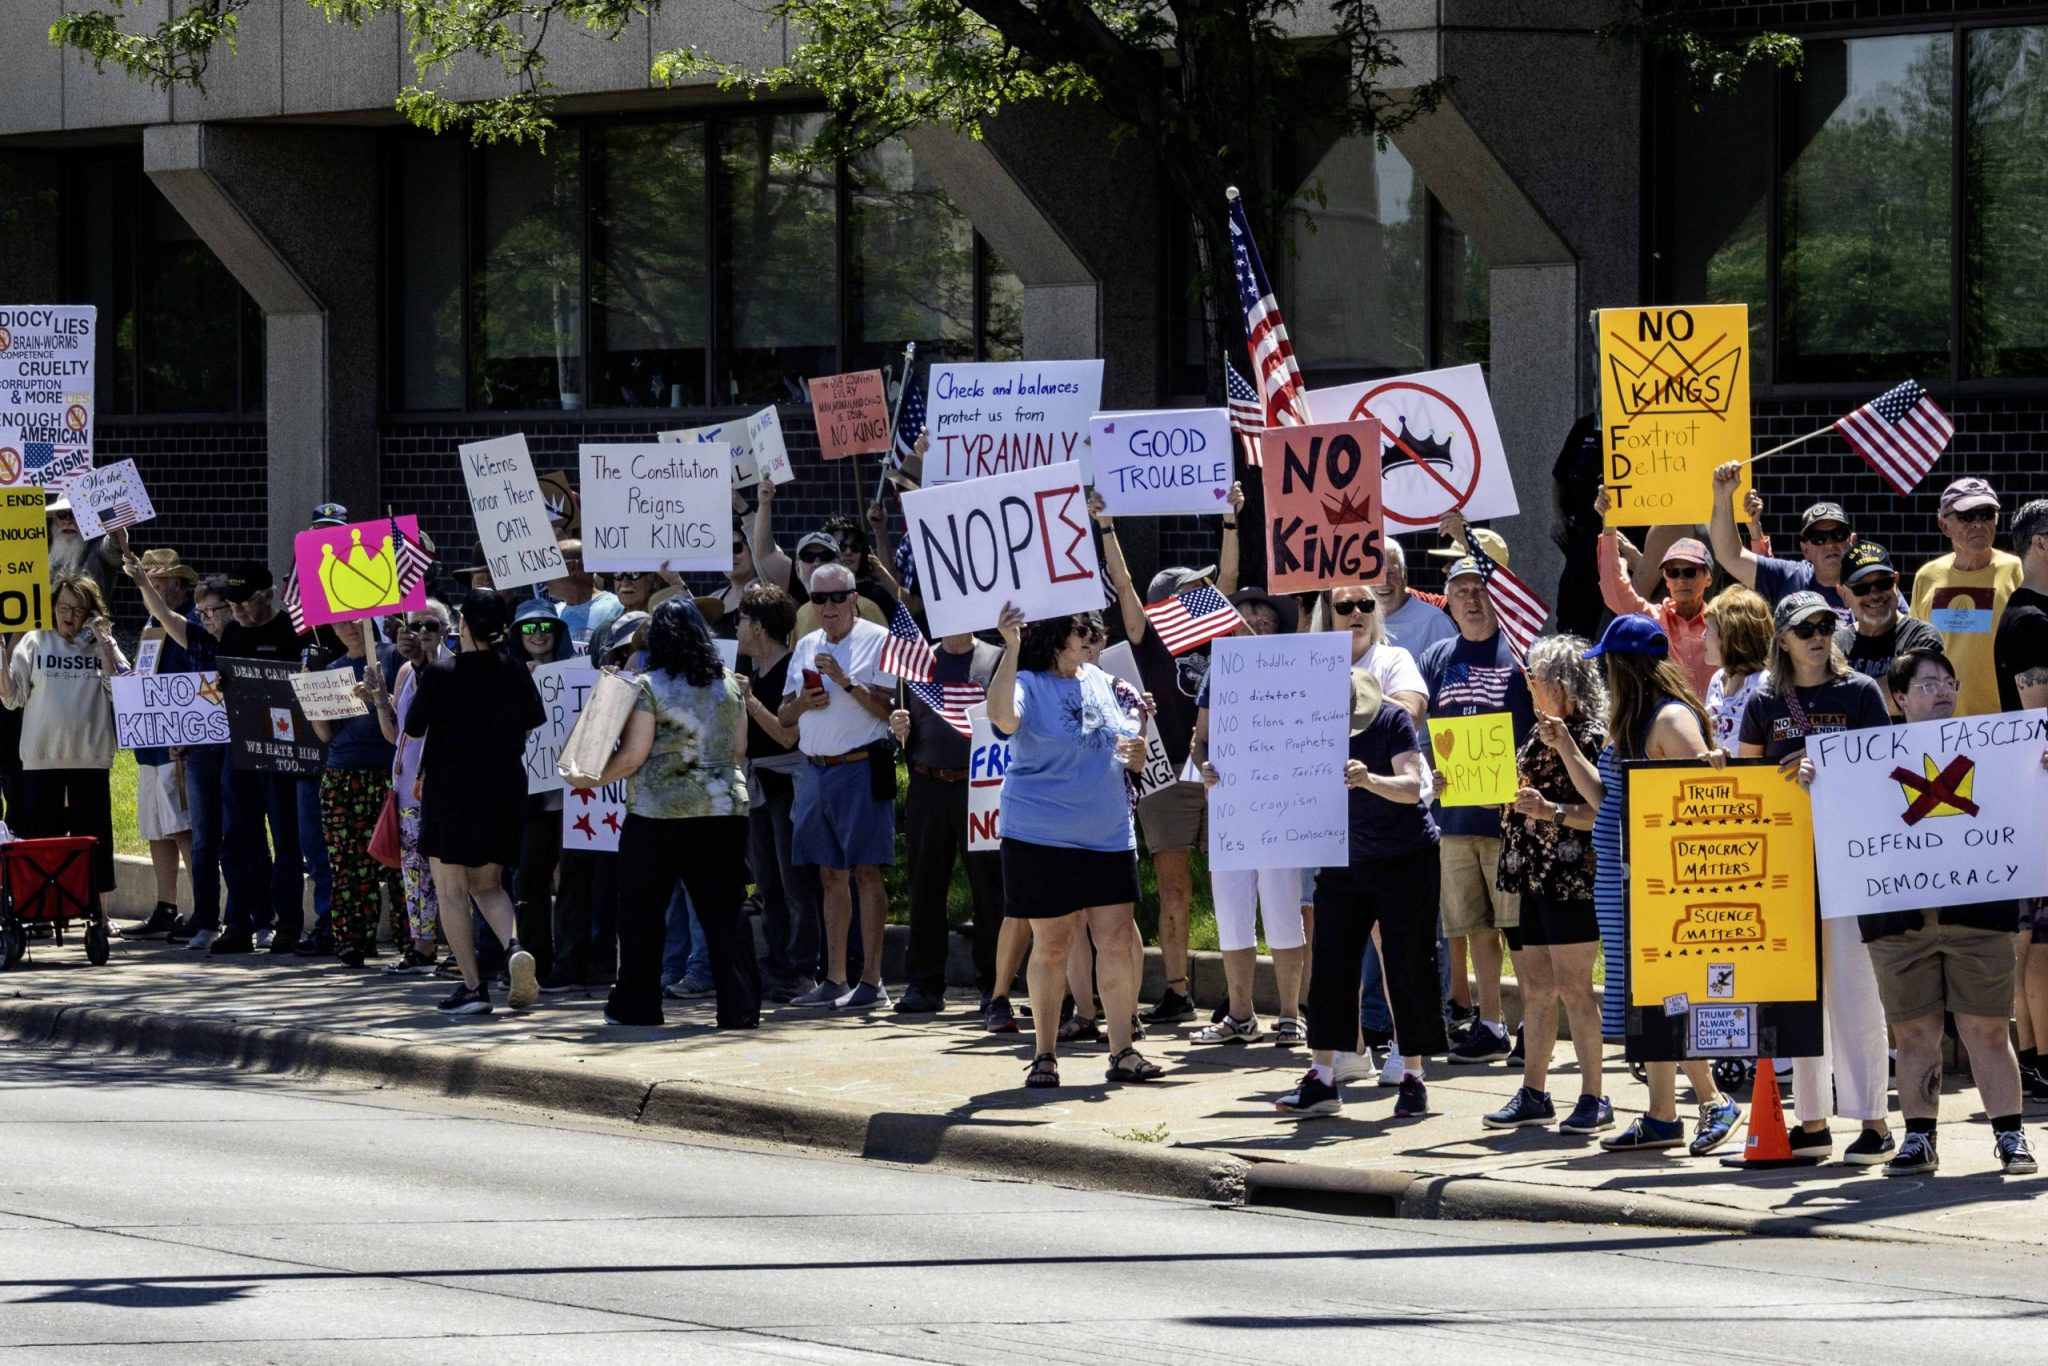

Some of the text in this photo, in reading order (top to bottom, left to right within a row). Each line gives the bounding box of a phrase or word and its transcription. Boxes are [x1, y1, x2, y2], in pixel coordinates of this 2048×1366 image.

[54, 318, 89, 335] LIES
[1639, 310, 1694, 342] NO
[13, 335, 78, 350] BRAIN-WORMS
[19, 360, 89, 376] CRUELTY
[0, 380, 62, 390] ORRUPTION
[833, 386, 857, 399] EVERY
[936, 372, 1080, 400] Checks and balances
[1632, 375, 1720, 407] KINGS
[11, 390, 90, 404] & MORE LIES
[0, 412, 62, 427] NOUGH
[938, 406, 1045, 433] protect us from
[20, 427, 88, 444] AMERICAN
[831, 418, 887, 446] NO KING!
[1129, 428, 1206, 458] GOOD
[1610, 419, 1700, 450] Foxtrot
[937, 431, 1078, 476] TYRANNY
[1282, 434, 1361, 494] NO
[1611, 449, 1686, 479] Delta
[30, 450, 85, 487] FASCISM
[470, 453, 517, 478] Veterns
[590, 455, 621, 480] The
[631, 455, 719, 479] Constitution
[1108, 462, 1227, 492] TROUBLE
[81, 469, 122, 490] We the
[7, 494, 43, 507] ENDS
[90, 485, 128, 507] People
[470, 480, 535, 512] honor their
[628, 487, 685, 520] Reigns
[1608, 485, 1673, 508] Taco
[0, 527, 46, 541] NOUGH
[497, 517, 531, 543] OATH
[594, 523, 716, 550] NOT KINGS
[919, 484, 1094, 602] NOPE
[1861, 544, 1882, 554] NAVY
[7, 561, 34, 575] SAY
[489, 546, 562, 579] NOT KINGS
[37, 655, 41, 669] I
[232, 665, 262, 679] DEAR
[1221, 650, 1345, 675] NO toddler Kings
[142, 675, 195, 708] NO
[312, 676, 331, 689] mad
[1218, 689, 1306, 706] NO dictators
[1218, 716, 1238, 734] NO
[1252, 714, 1284, 728] Felons
[1311, 710, 1350, 722] President
[1463, 706, 1476, 715] USA
[1774, 714, 1846, 730] NO RTREAT
[118, 711, 230, 747] KINGS
[1775, 731, 1786, 740] NO
[246, 740, 320, 761] WE HATE HIM
[1217, 743, 1236, 759] NO
[1285, 731, 1334, 753] Prophets
[1819, 730, 1909, 767] FUCK
[1217, 763, 1332, 788] NO Taco Tariffs
[1445, 763, 1501, 796] ARMY
[1687, 785, 1729, 800] TRUTH
[1217, 804, 1235, 819] NO
[1683, 803, 1755, 817] MATTERS
[1218, 832, 1244, 852] Yes
[1286, 829, 1345, 844] Democracy
[1678, 841, 1759, 860] DEMOCRACY
[1848, 826, 2014, 858] DEFEND OUR
[1684, 862, 1750, 882] MATTERS
[1867, 864, 2018, 897] DEMOCRACY
[1695, 908, 1753, 923] SCIENCE
[1681, 927, 1756, 941] MATTERS
[1699, 1011, 1731, 1019] TRUMP
[1699, 1028, 1746, 1036] CHICKENS
